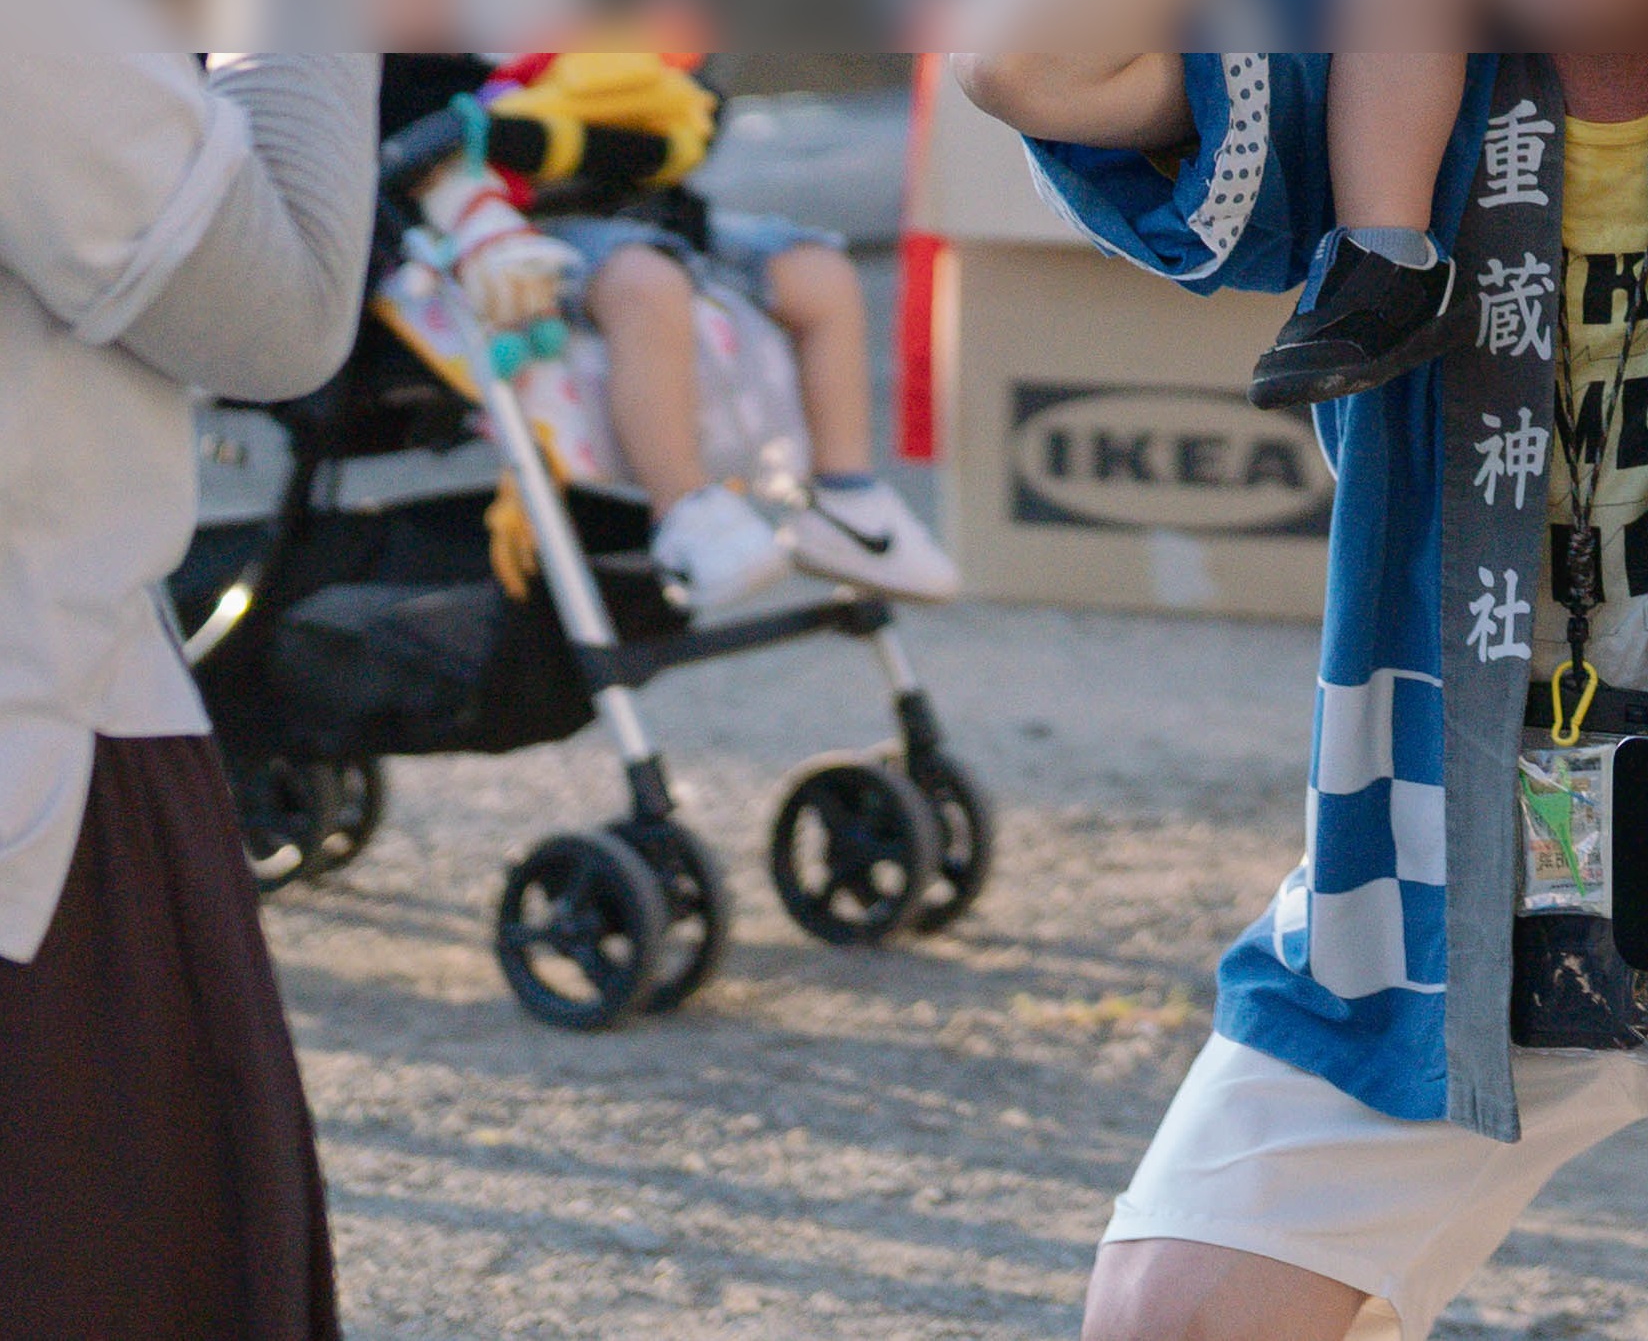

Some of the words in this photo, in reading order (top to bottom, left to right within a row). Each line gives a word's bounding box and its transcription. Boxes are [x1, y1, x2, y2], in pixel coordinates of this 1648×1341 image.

[1047, 427, 1305, 489] IKEA
[1466, 99, 1556, 663] 重蔵神社
